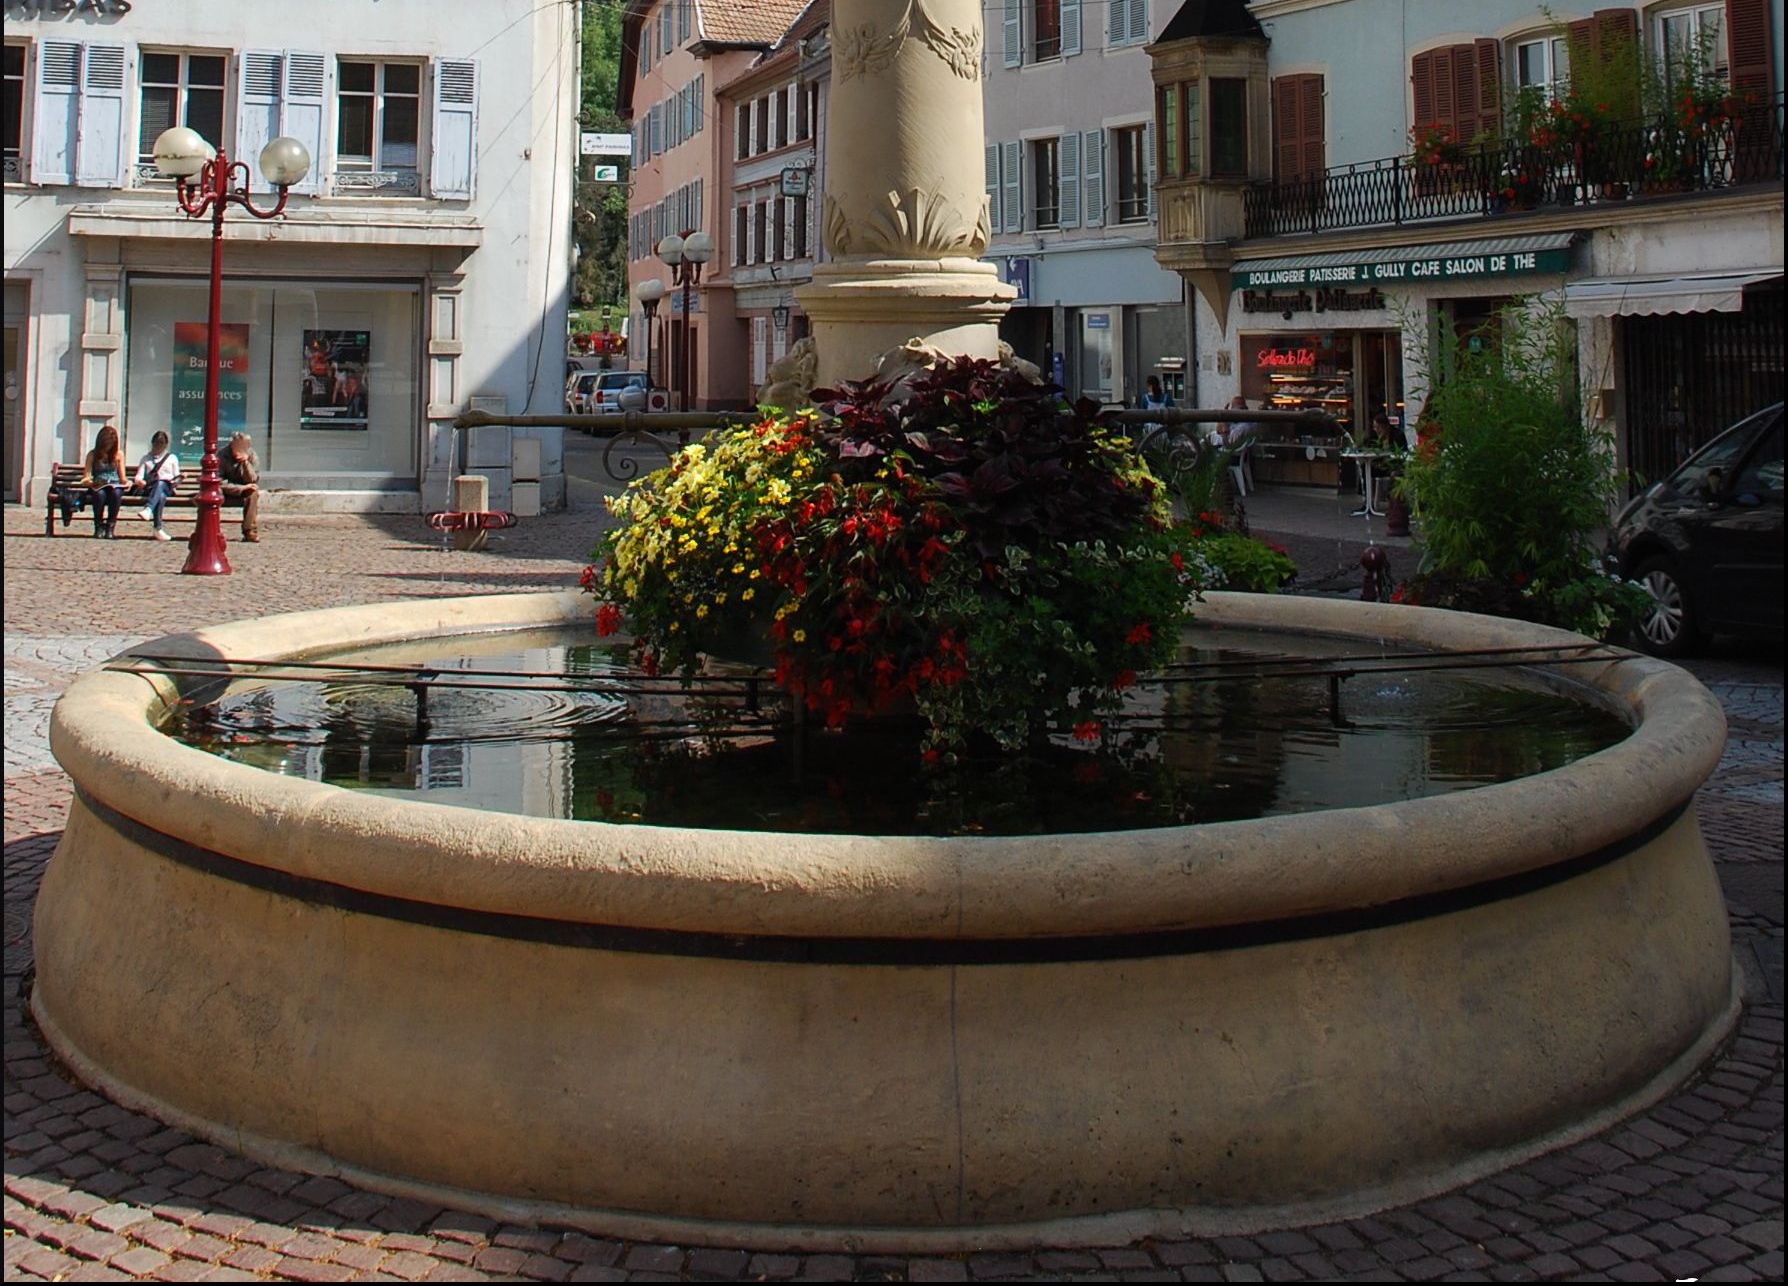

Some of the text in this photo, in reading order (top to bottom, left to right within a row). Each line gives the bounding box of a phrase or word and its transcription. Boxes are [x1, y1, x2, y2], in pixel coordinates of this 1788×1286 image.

[1249, 269, 1305, 285] BOULANGERIE
[1309, 266, 1356, 282] PATISSERIE
[1374, 263, 1406, 278] GULLY
[1411, 260, 1440, 276] CAFE
[1445, 257, 1485, 275] SALON
[1490, 255, 1506, 271] DE
[1513, 253, 1536, 270] THE
[189, 356, 233, 369] Baue
[178, 389, 242, 401] assunces
